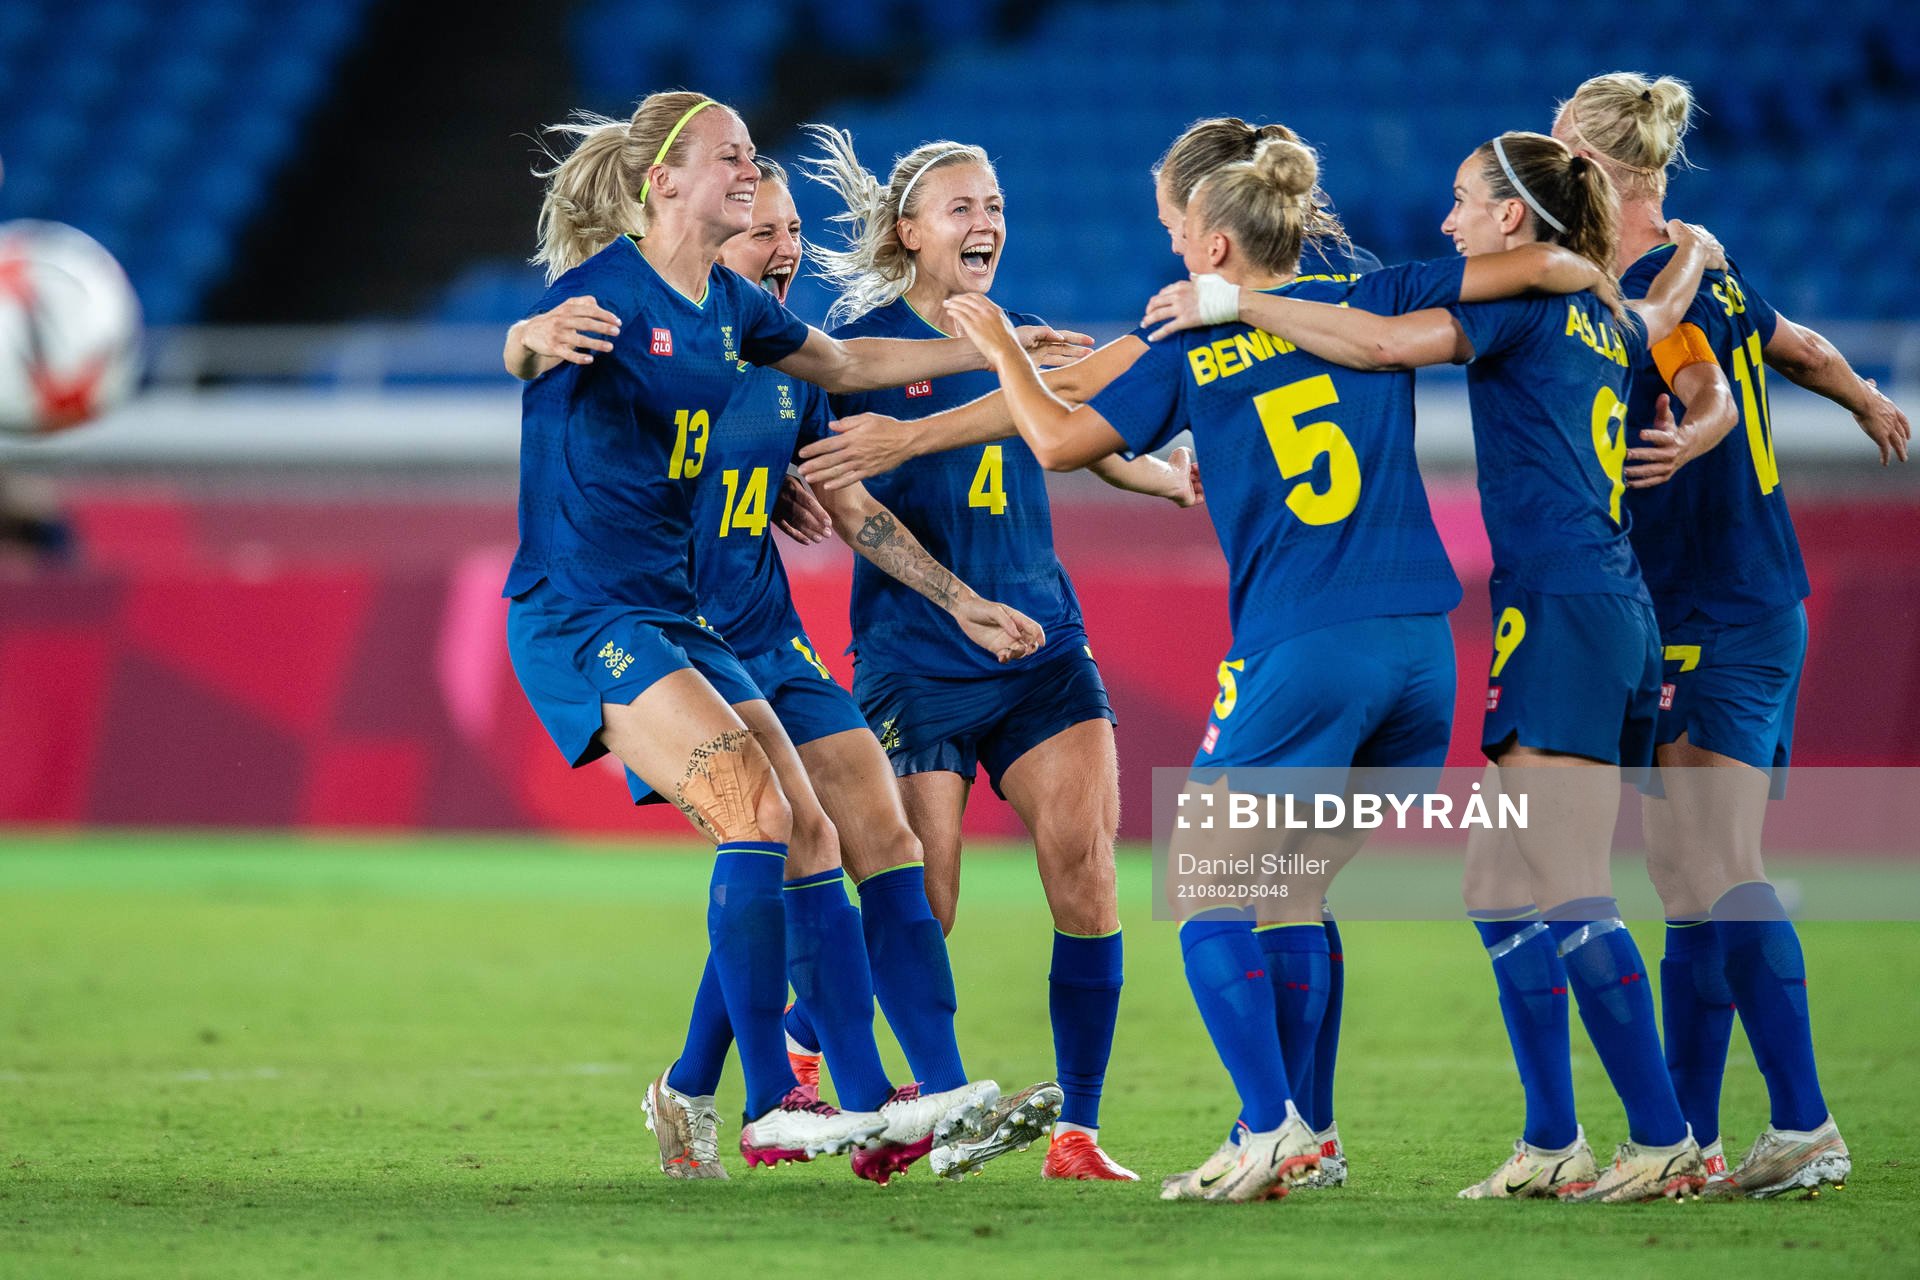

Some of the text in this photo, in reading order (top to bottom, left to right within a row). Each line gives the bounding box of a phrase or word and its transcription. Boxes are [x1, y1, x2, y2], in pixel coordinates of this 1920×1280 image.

[653, 342, 671, 353] QLO
[654, 331, 670, 341] UNI
[724, 351, 738, 361] SWE
[780, 409, 796, 419] SWE
[908, 384, 929, 396] QLO
[668, 409, 710, 479] 13
[1253, 373, 1362, 526] 5
[1591, 385, 1628, 525] 9
[719, 467, 769, 538] 14
[968, 445, 1007, 515] 4
[612, 653, 635, 678] SWE
[1490, 606, 1526, 677] 9
[1213, 658, 1245, 720] 5
